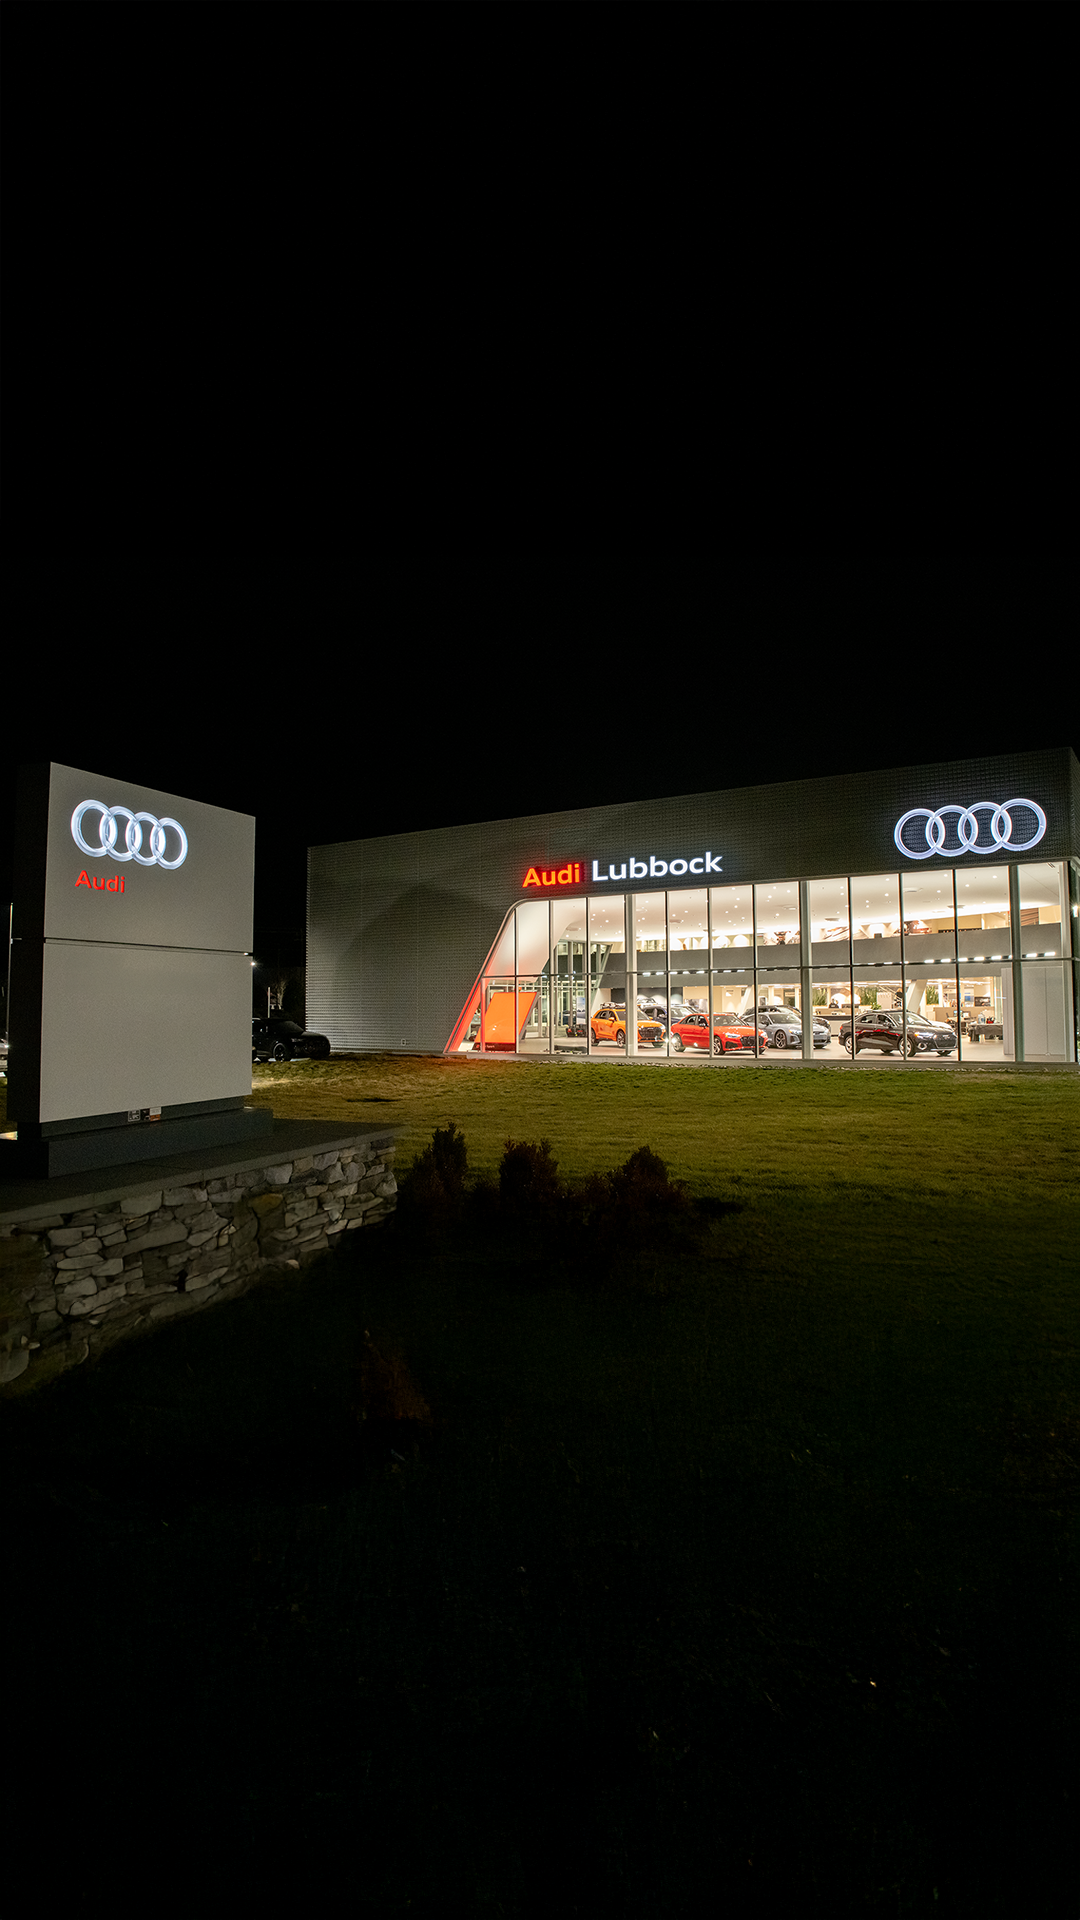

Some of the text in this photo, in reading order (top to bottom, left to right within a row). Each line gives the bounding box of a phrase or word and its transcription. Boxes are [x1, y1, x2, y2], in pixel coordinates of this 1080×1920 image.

[74, 869, 125, 893] Audi
[522, 851, 723, 888] Audi Lubbock
